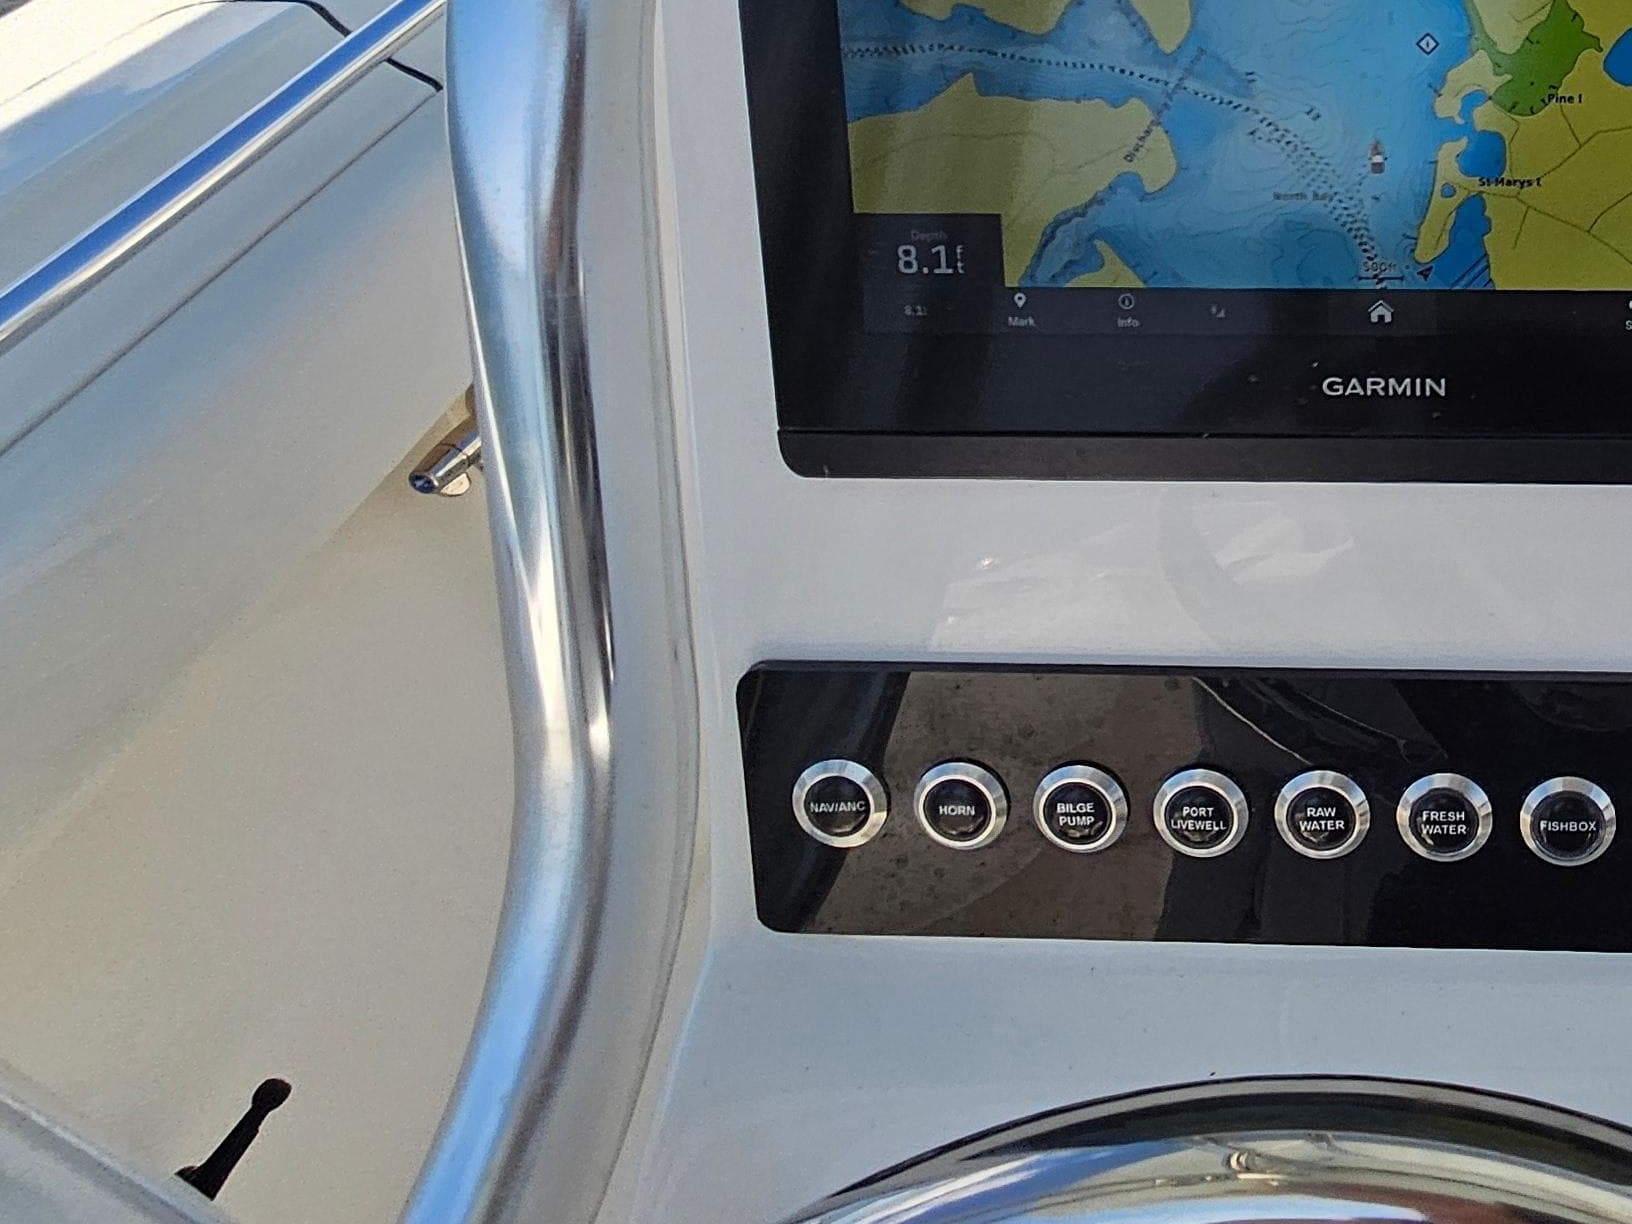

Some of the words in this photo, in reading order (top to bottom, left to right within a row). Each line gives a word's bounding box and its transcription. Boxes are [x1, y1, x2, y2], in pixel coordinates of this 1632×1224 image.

[1547, 93, 1574, 105] Pine
[897, 244, 954, 275] 8.1
[1008, 316, 1035, 328] Mark
[1117, 316, 1140, 328] Info
[1321, 376, 1447, 397] GARMIN
[809, 800, 866, 814] NAV/ANC
[938, 804, 976, 816] HORN
[1056, 802, 1095, 814] BILGE
[1182, 806, 1215, 817] PORT
[1306, 806, 1337, 818] RAW
[1058, 815, 1095, 827] PUMP
[1422, 810, 1465, 823] FRESH
[1170, 819, 1227, 831] LIVEWELL
[1299, 819, 1346, 832] WATER
[1421, 823, 1467, 836] WATER
[1539, 820, 1597, 832] FISHBOX
